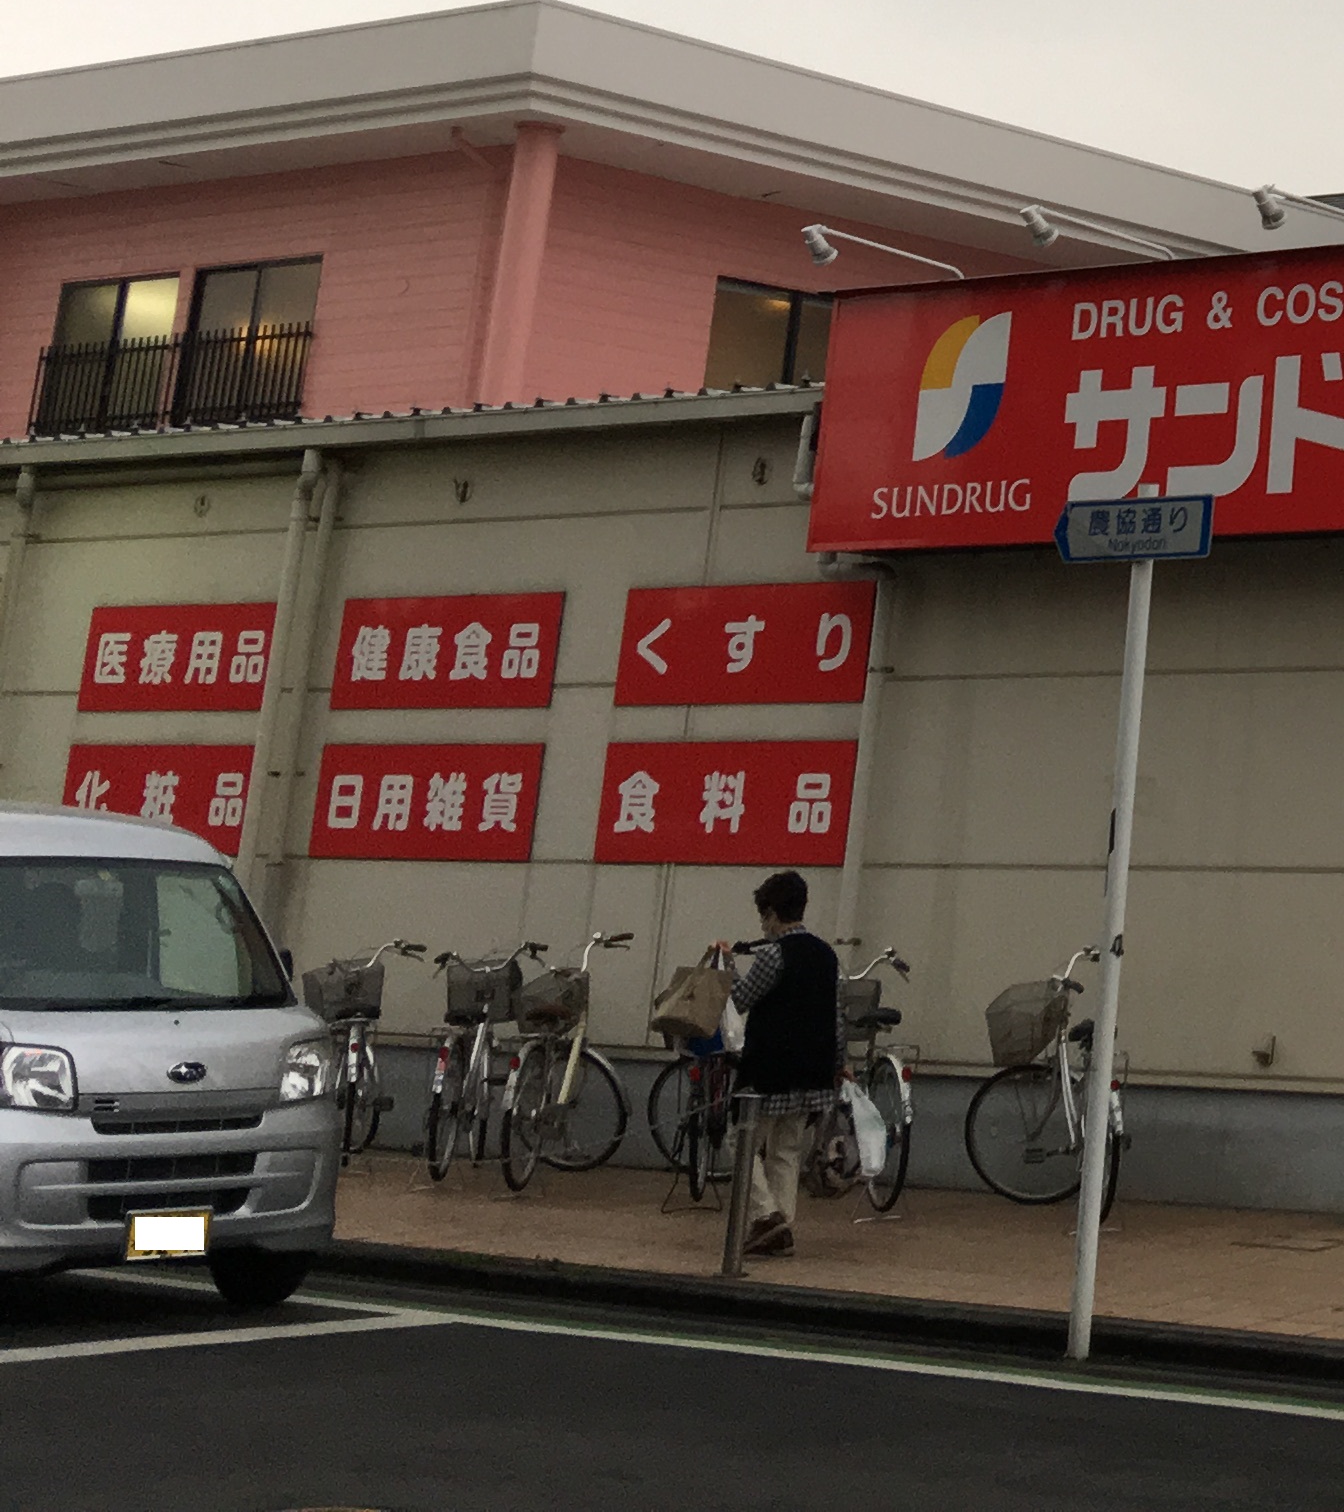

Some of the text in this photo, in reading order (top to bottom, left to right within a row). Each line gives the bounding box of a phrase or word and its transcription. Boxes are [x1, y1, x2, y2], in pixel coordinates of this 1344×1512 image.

[1071, 293, 1185, 341] DRUG
[1207, 297, 1233, 330] &
[870, 478, 1033, 521] SUNDRUG
[1088, 506, 1188, 536] 農協通り
[93, 629, 266, 686] 医療用品
[350, 622, 541, 682] 健康食品
[635, 613, 853, 676] くすり
[74, 772, 245, 829] 化粧品
[327, 772, 525, 834] 日用雑貨
[613, 771, 832, 836] 食料品
